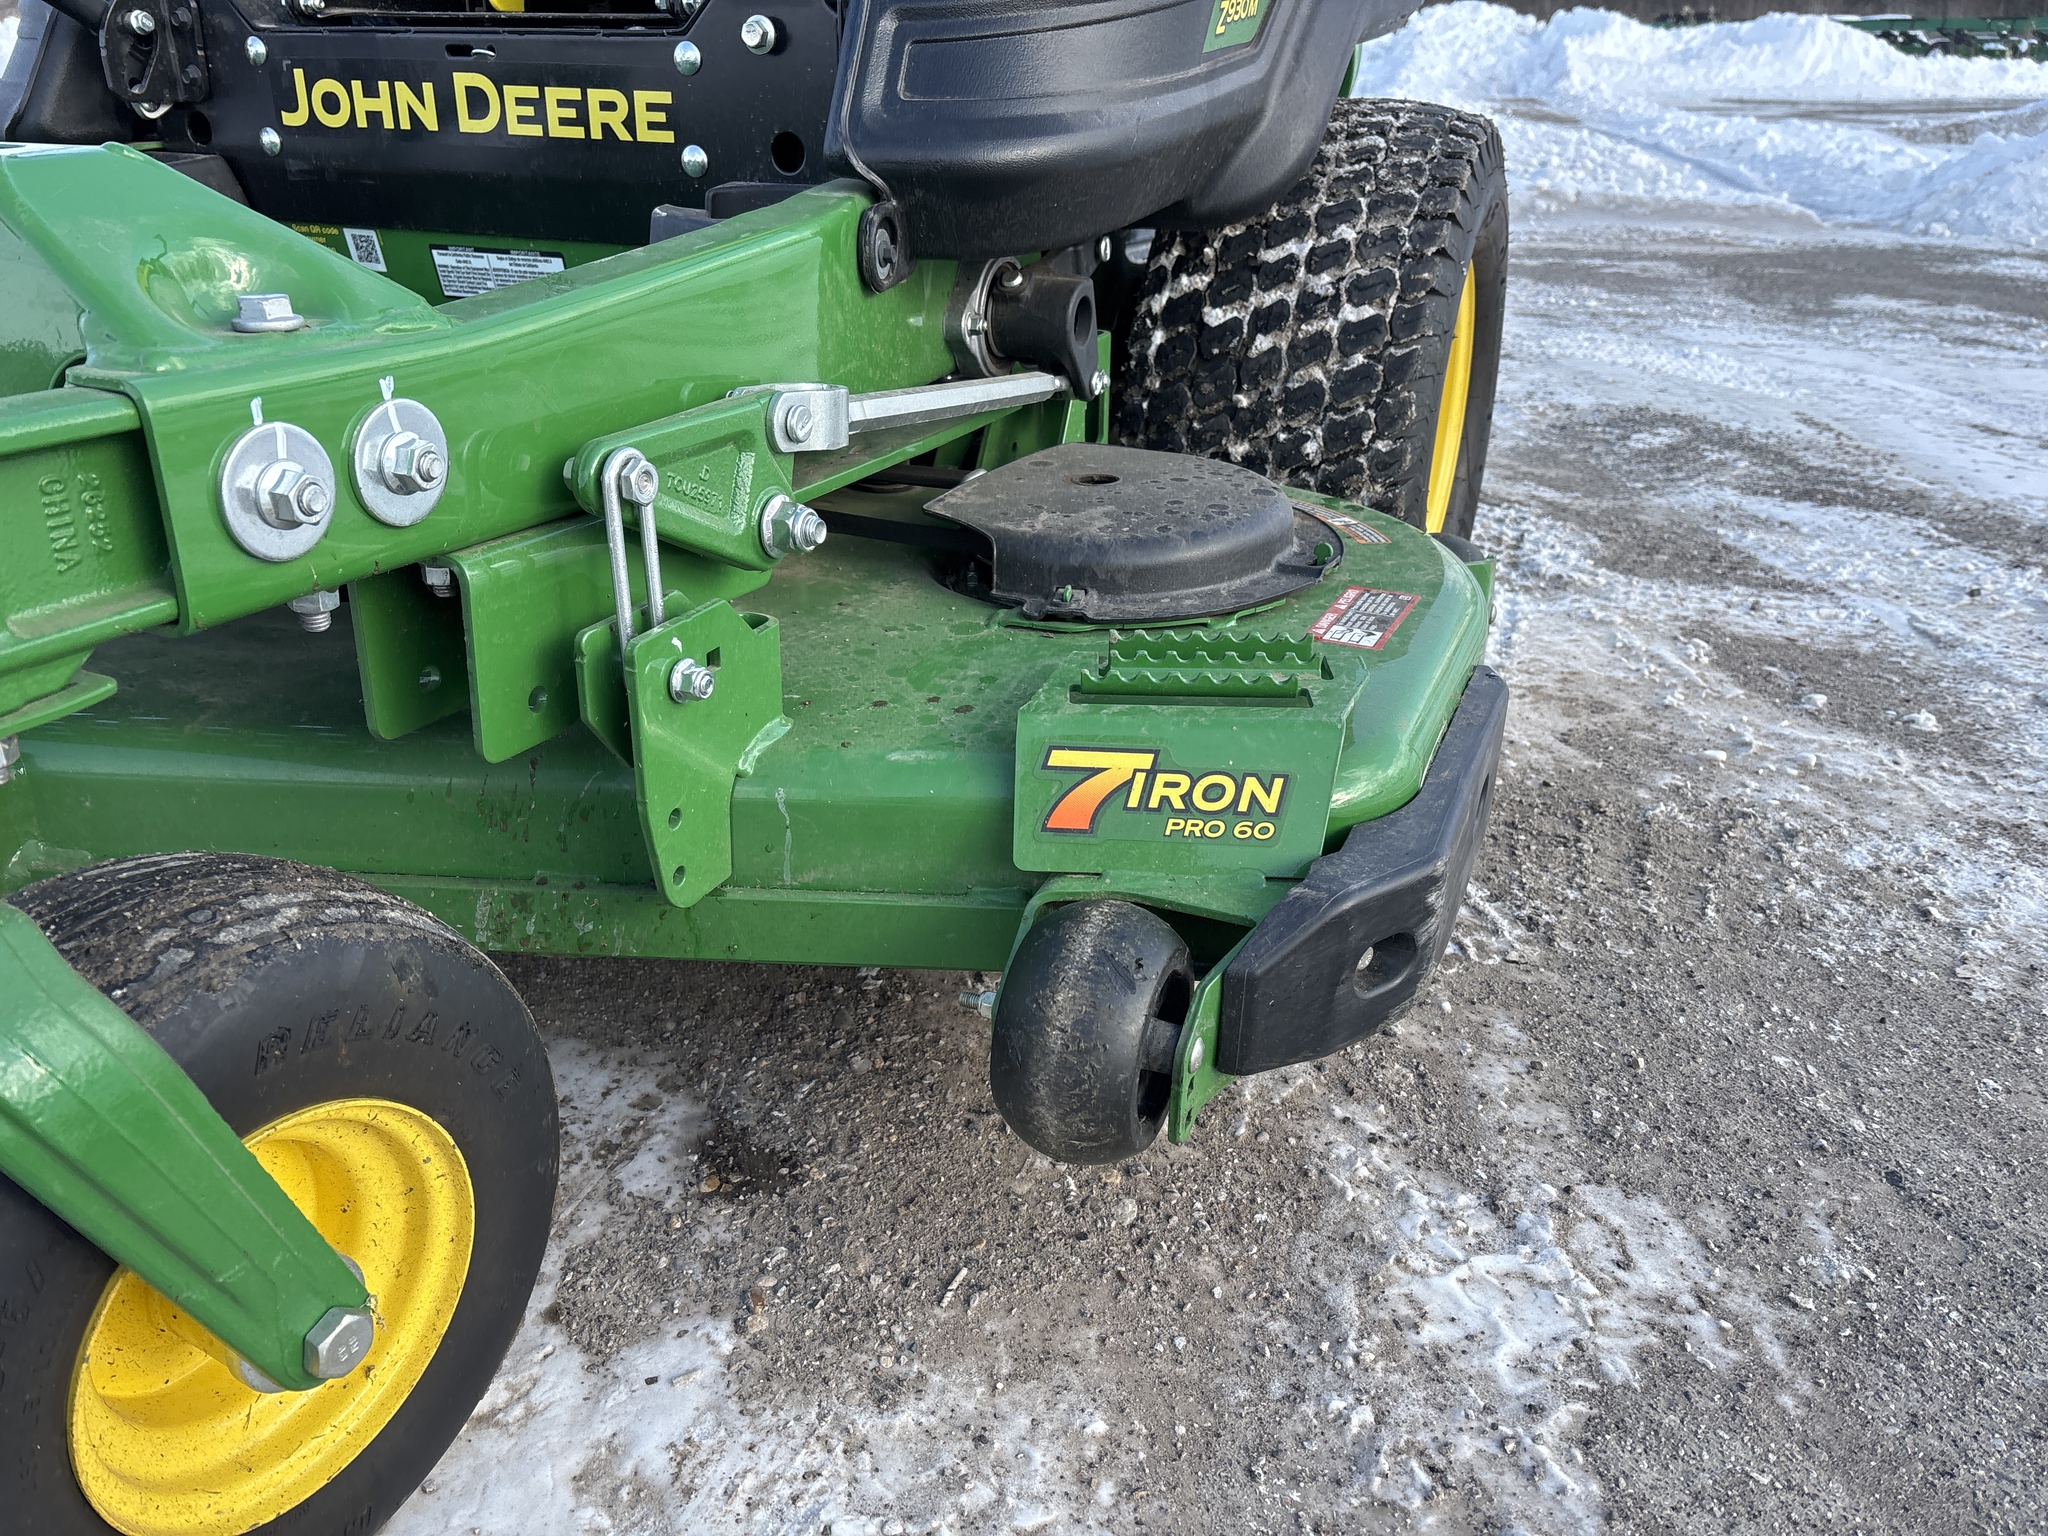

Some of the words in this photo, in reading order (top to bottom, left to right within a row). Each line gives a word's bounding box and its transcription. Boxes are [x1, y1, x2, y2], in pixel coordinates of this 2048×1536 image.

[1215, 0, 1259, 35] Z930M
[281, 68, 439, 131] JOHN
[452, 71, 676, 144] DEERE
[38, 474, 82, 573] CHINA
[1163, 817, 1227, 838] PRO
[1232, 820, 1276, 840] 60
[253, 1003, 523, 1103] RELIANCE
